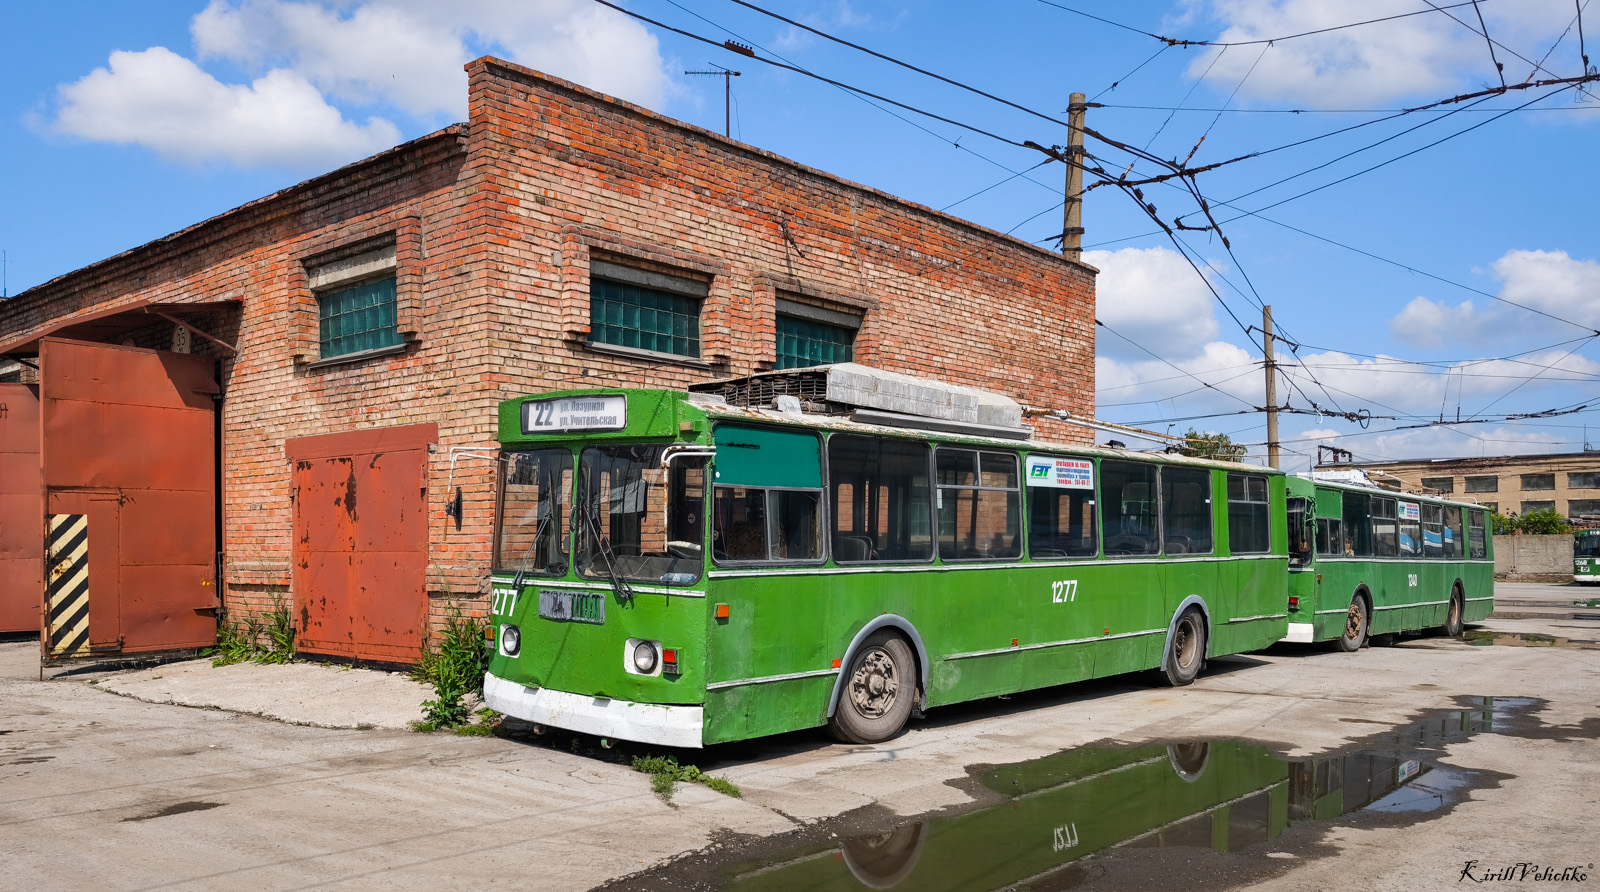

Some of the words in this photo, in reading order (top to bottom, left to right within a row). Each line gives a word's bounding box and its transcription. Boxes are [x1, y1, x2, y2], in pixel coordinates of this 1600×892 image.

[535, 401, 554, 426] 22
[560, 403, 570, 413] ул.
[571, 401, 605, 413] Лазурная
[560, 416, 569, 426] ул.
[570, 414, 617, 426] Учительская
[1052, 580, 1078, 603] 1277
